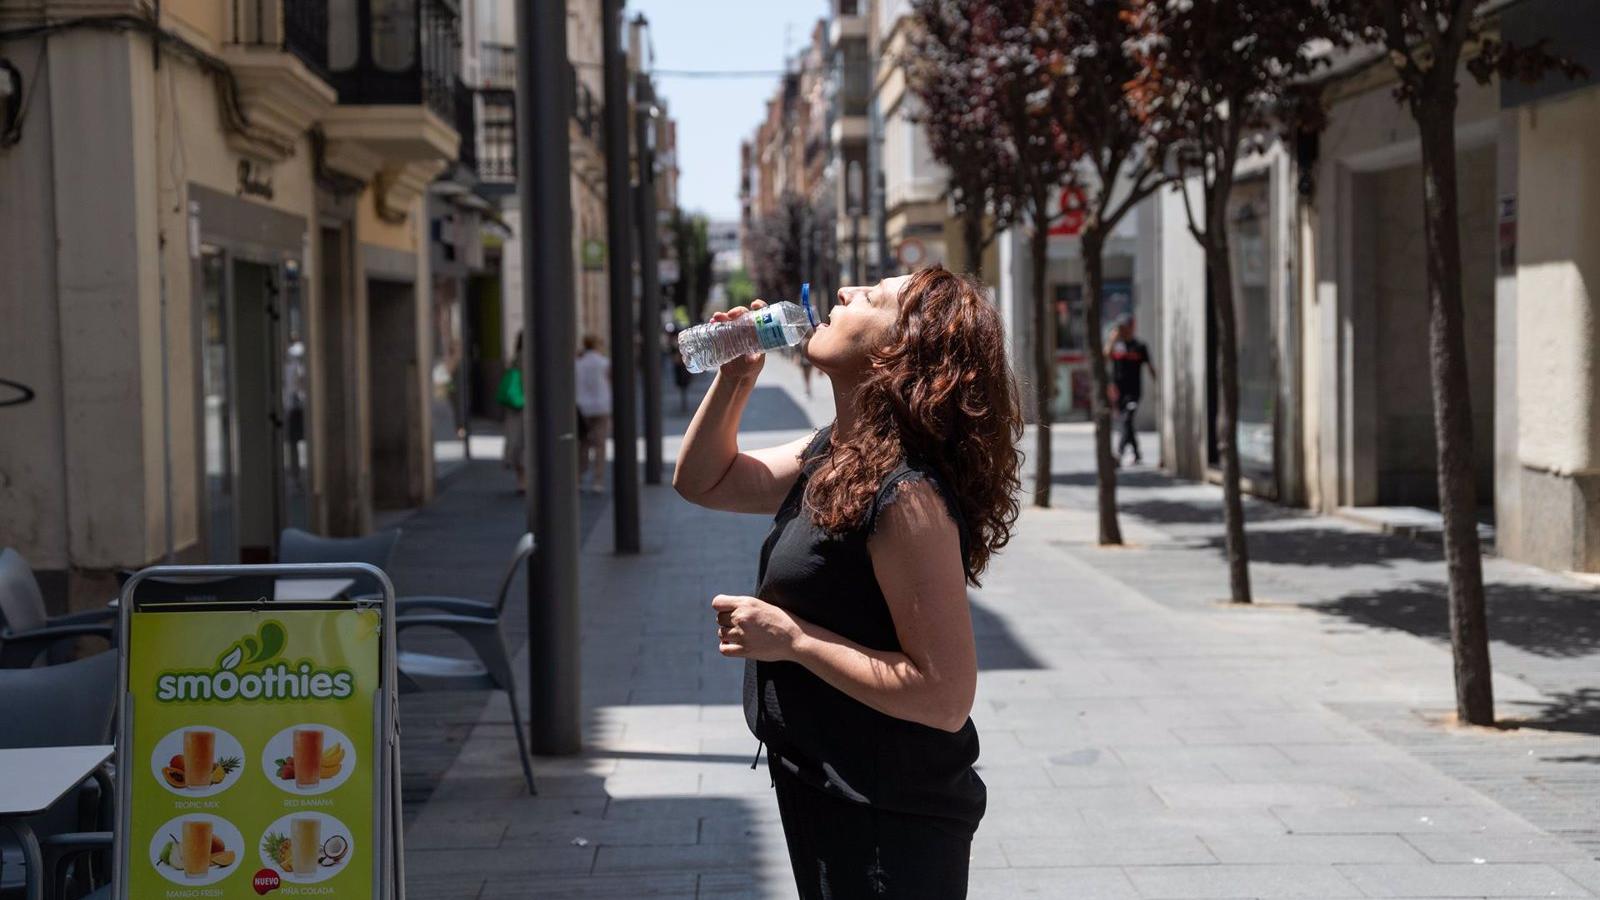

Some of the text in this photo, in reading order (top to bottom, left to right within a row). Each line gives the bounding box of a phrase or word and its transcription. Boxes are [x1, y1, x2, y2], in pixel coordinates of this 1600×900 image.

[284, 799, 334, 807] RED BANANA
[254, 877, 279, 886] NUEVO
[166, 889, 224, 898] MANGO FRESH
[301, 887, 334, 895] COLADA
